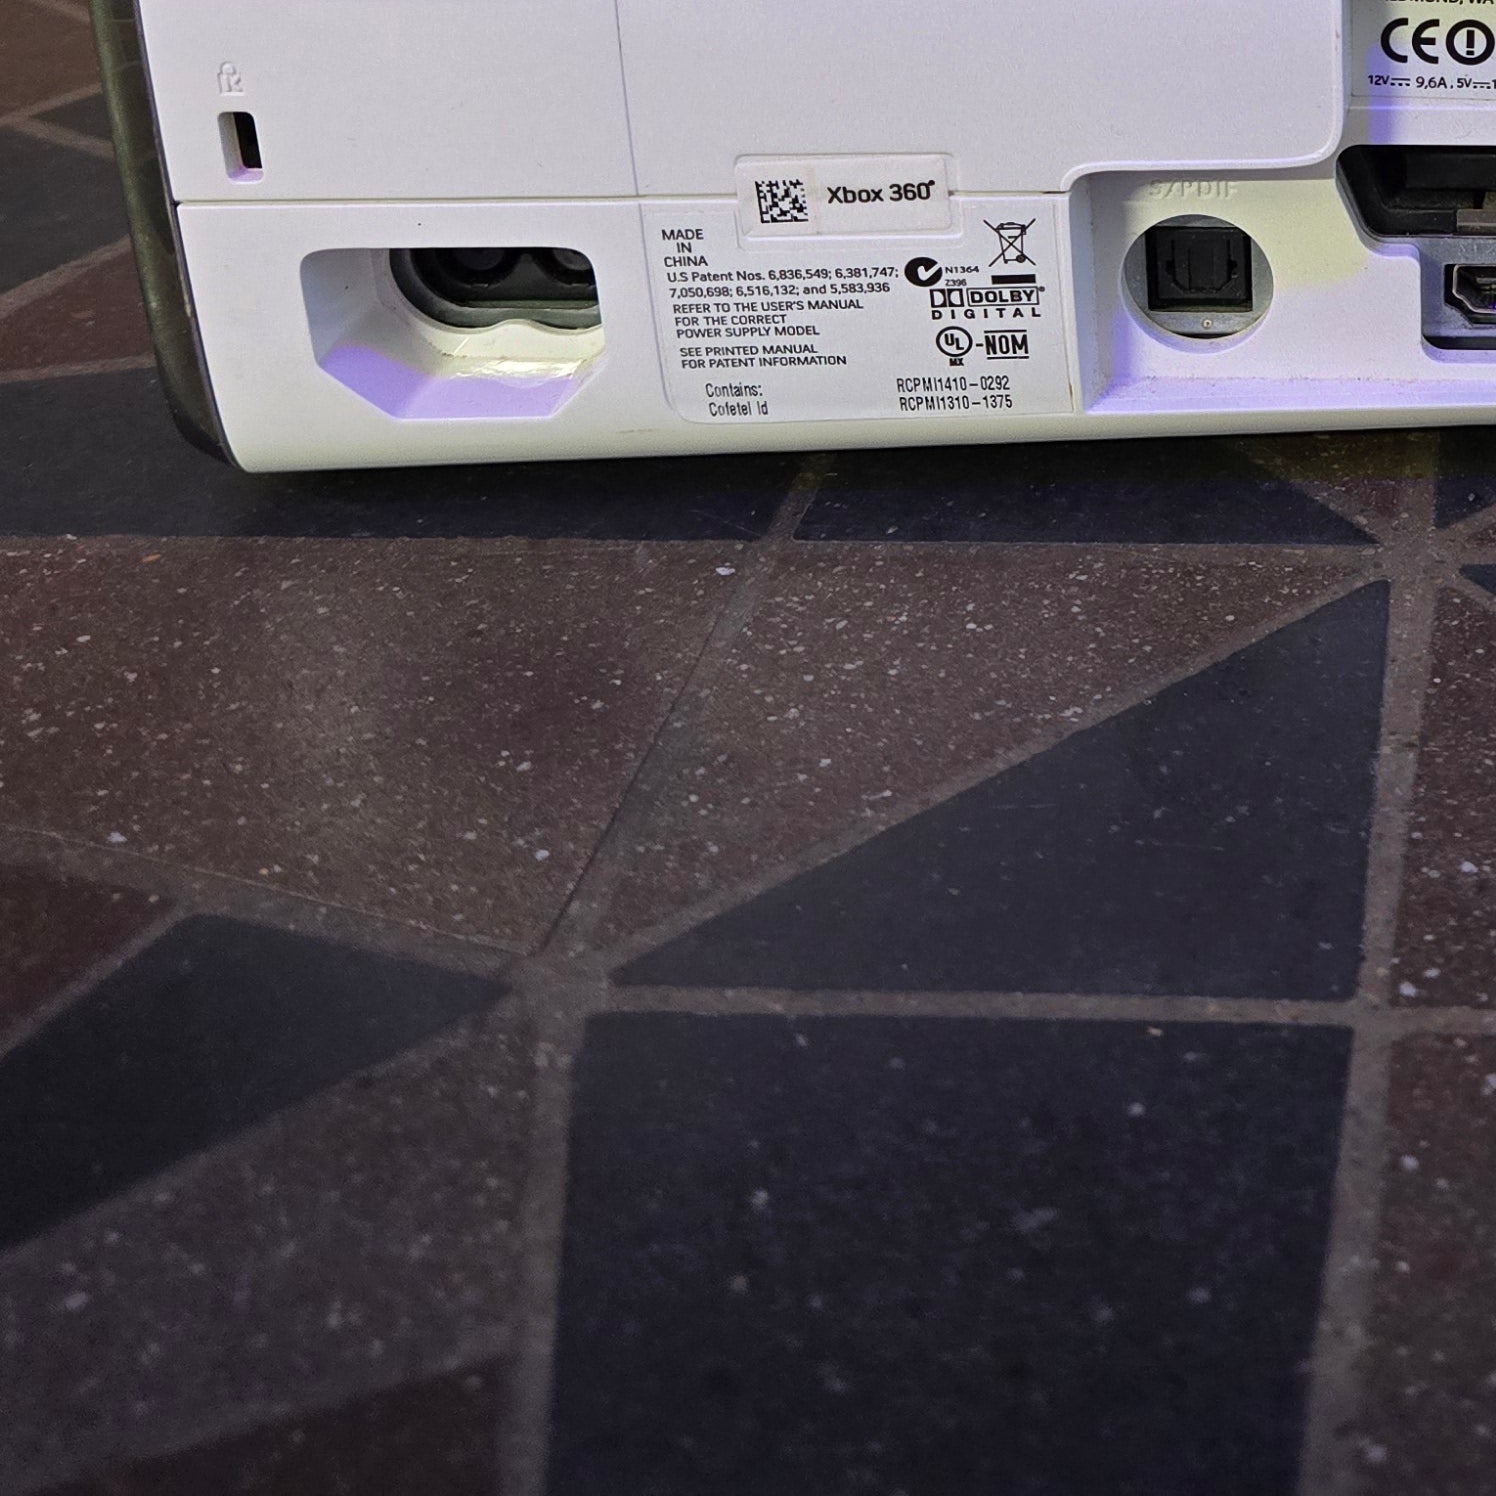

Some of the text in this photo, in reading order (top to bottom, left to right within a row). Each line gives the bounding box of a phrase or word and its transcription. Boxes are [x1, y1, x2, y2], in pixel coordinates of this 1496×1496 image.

[1380, 17, 1440, 64] CE
[826, 185, 885, 205] Xbox
[1149, 178, 1238, 199] S/PDIF
[661, 228, 705, 241] MADE
[676, 241, 693, 254] IN
[663, 255, 709, 268] CHINA
[666, 266, 899, 283] U.S Patent Nos. 6,836,549; 6,381,747;
[944, 265, 980, 274] N1364
[668, 281, 891, 300] 7,050,698; 6,516,132; and 5,583,936
[970, 290, 1035, 303] DOLBY
[672, 298, 865, 314] REFER TO THE USER'S MANUAL
[931, 307, 1041, 320] DIGITAL
[674, 313, 788, 327] FOR THE CORRECT
[676, 325, 821, 339] POWER SUPPLY MODEL
[944, 333, 965, 351] UL
[679, 343, 819, 358] SEE PRINTED MANUAL
[681, 355, 847, 370] FOR PATENT INFORMATION
[948, 358, 965, 367] MX
[705, 381, 763, 398] Contains:
[708, 400, 769, 417] Cofetel Id
